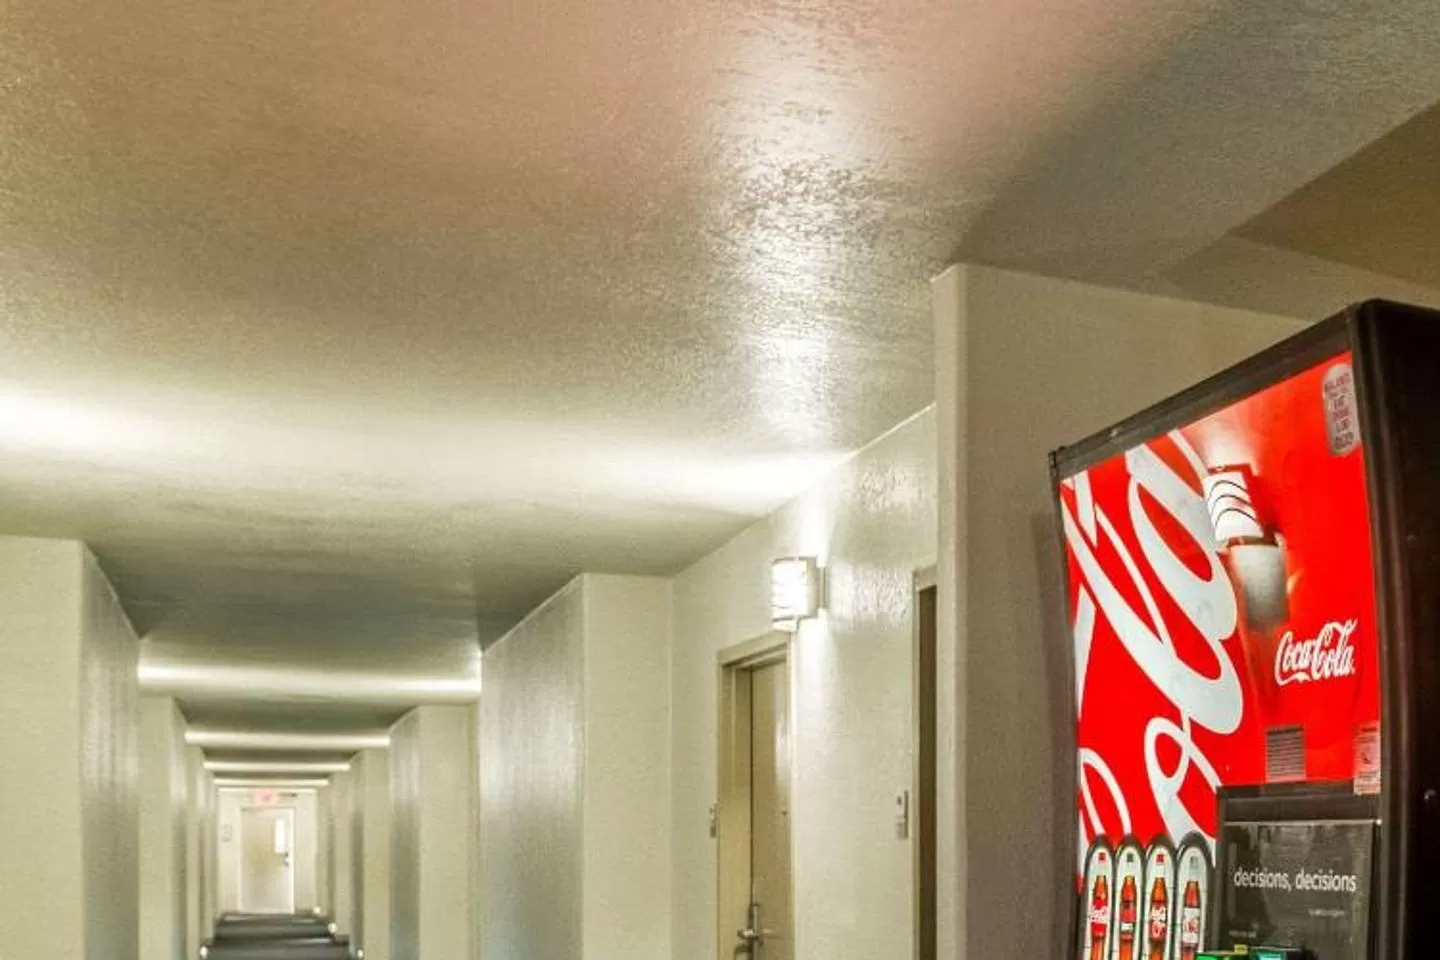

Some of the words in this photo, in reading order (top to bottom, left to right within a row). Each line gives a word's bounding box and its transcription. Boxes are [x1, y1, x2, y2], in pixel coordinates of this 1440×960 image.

[1275, 618, 1358, 686] Coca-Cola
[1234, 866, 1292, 892] decisions,
[1295, 867, 1357, 892] decisions
